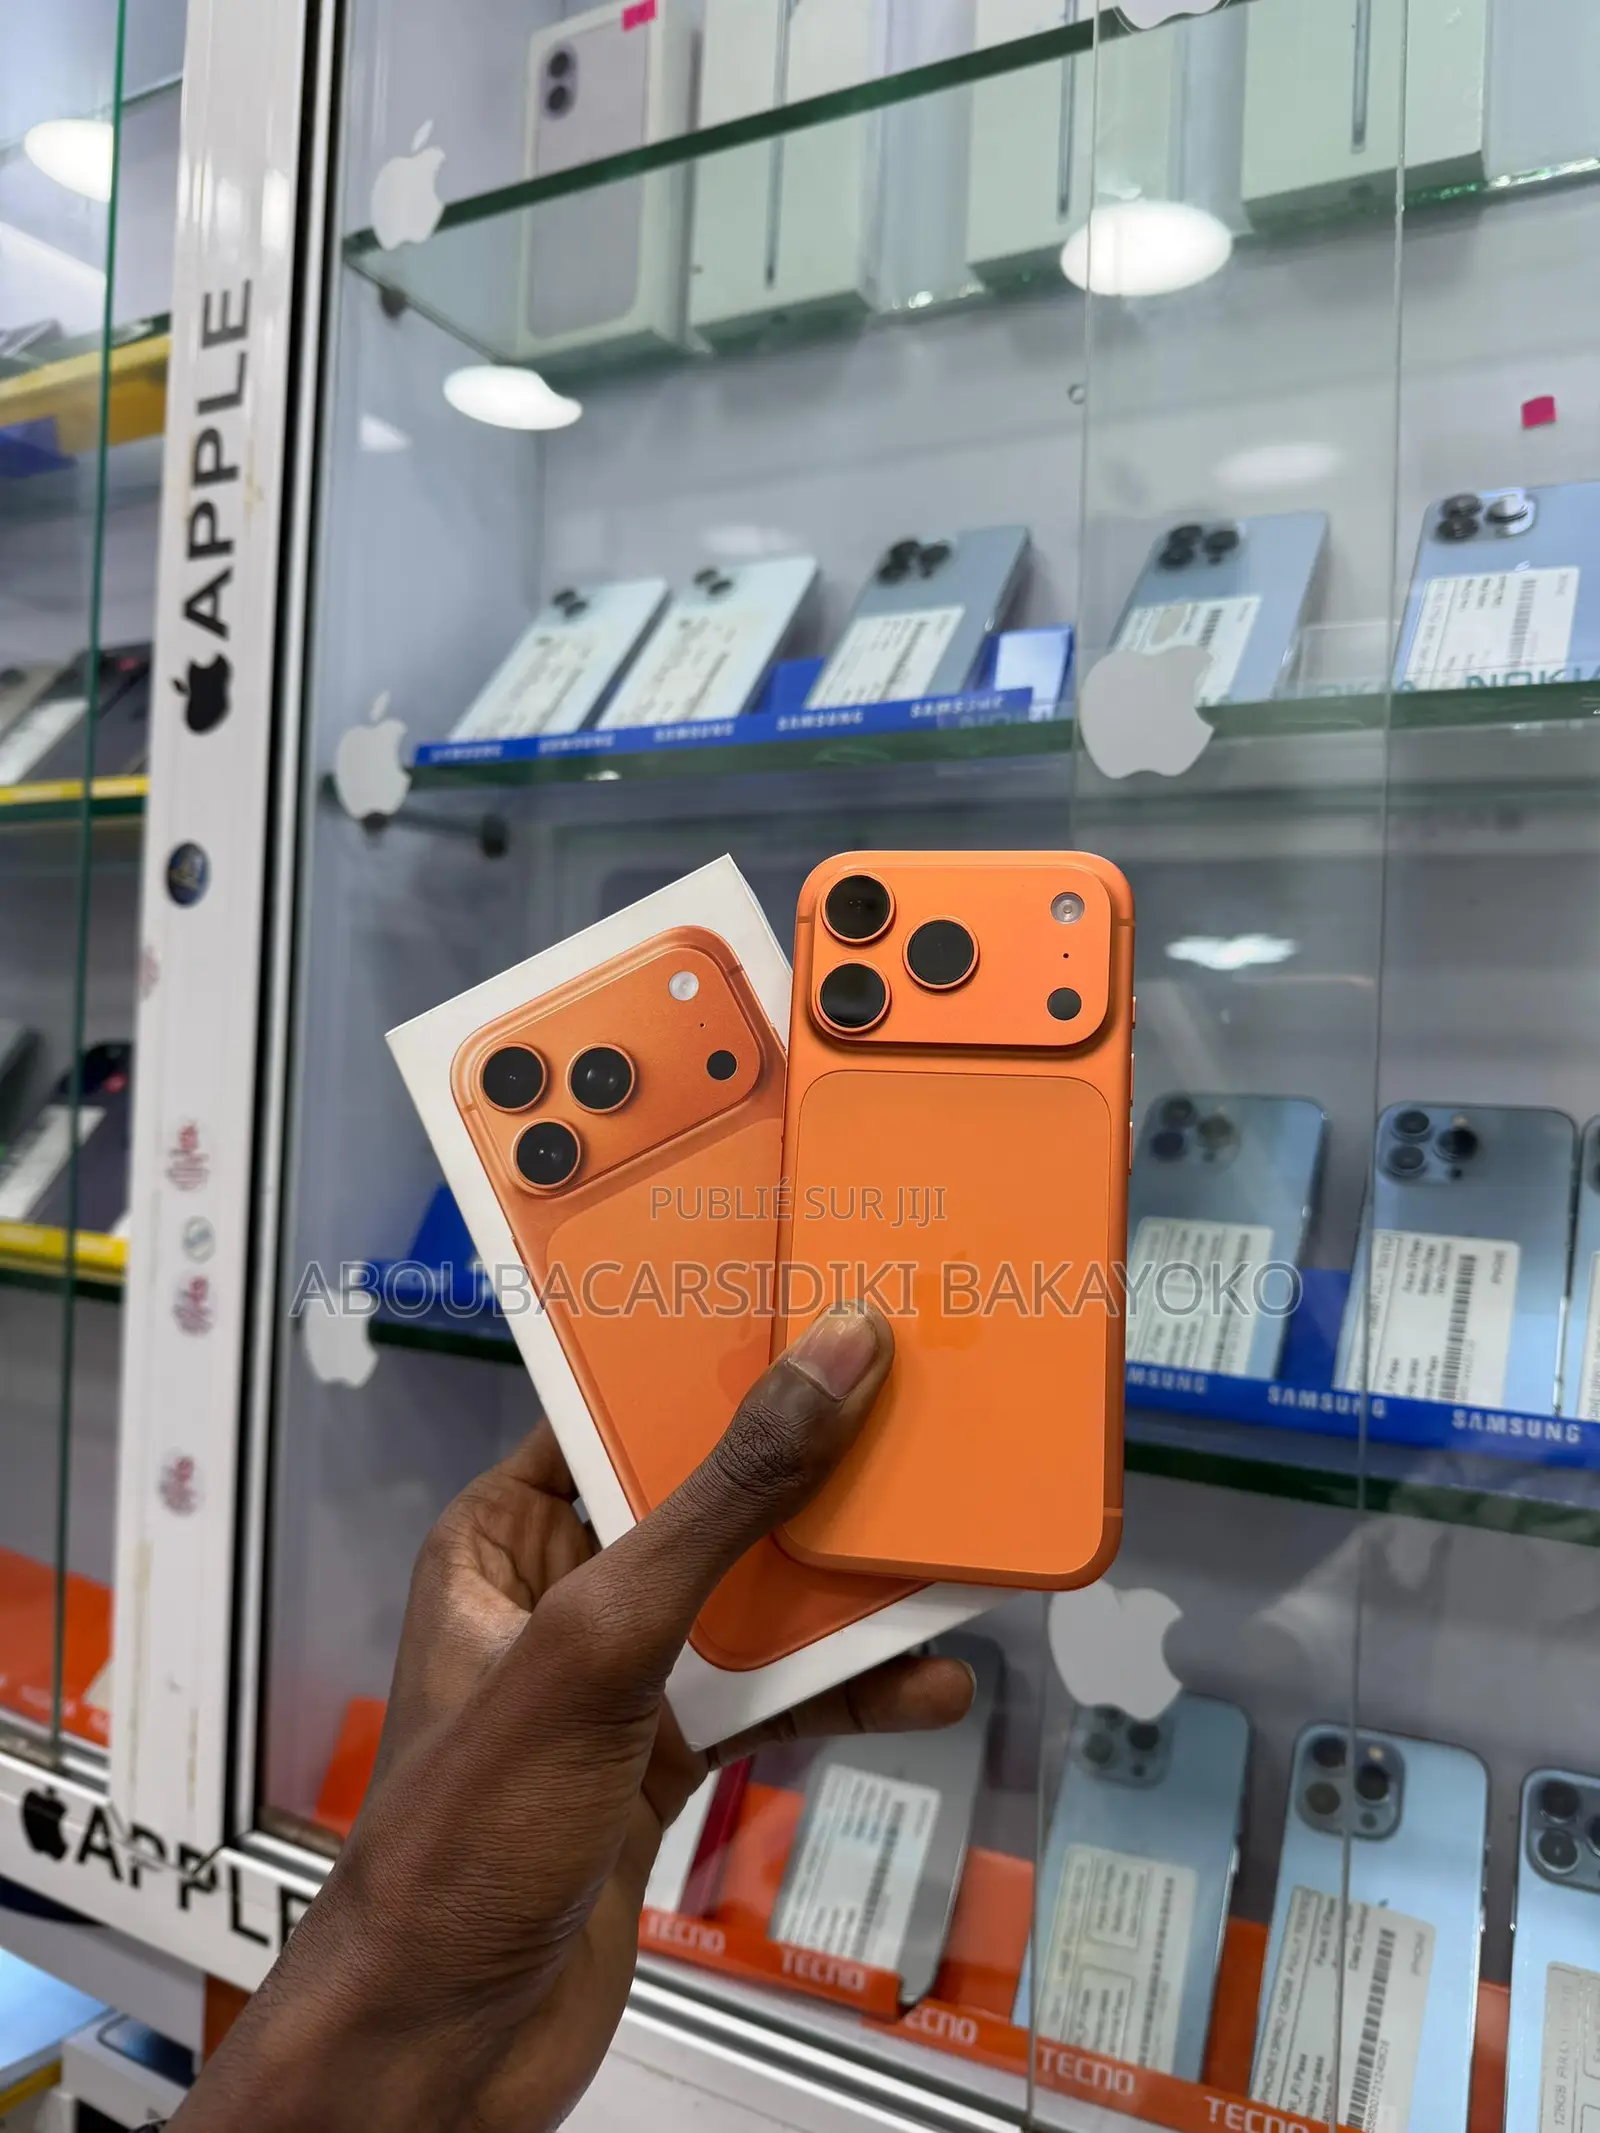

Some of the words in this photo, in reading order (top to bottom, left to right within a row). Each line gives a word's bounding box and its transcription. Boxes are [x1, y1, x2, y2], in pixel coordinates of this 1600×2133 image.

[182, 279, 252, 641] APPLE
[776, 708, 864, 731] SAMSUNG
[1451, 1408, 1582, 1445] SAMSUNG
[647, 1906, 726, 1955] TECNO
[780, 1948, 867, 1993] TECNO
[904, 2007, 978, 2046] ECNO
[1036, 2043, 1135, 2097] TECNO
